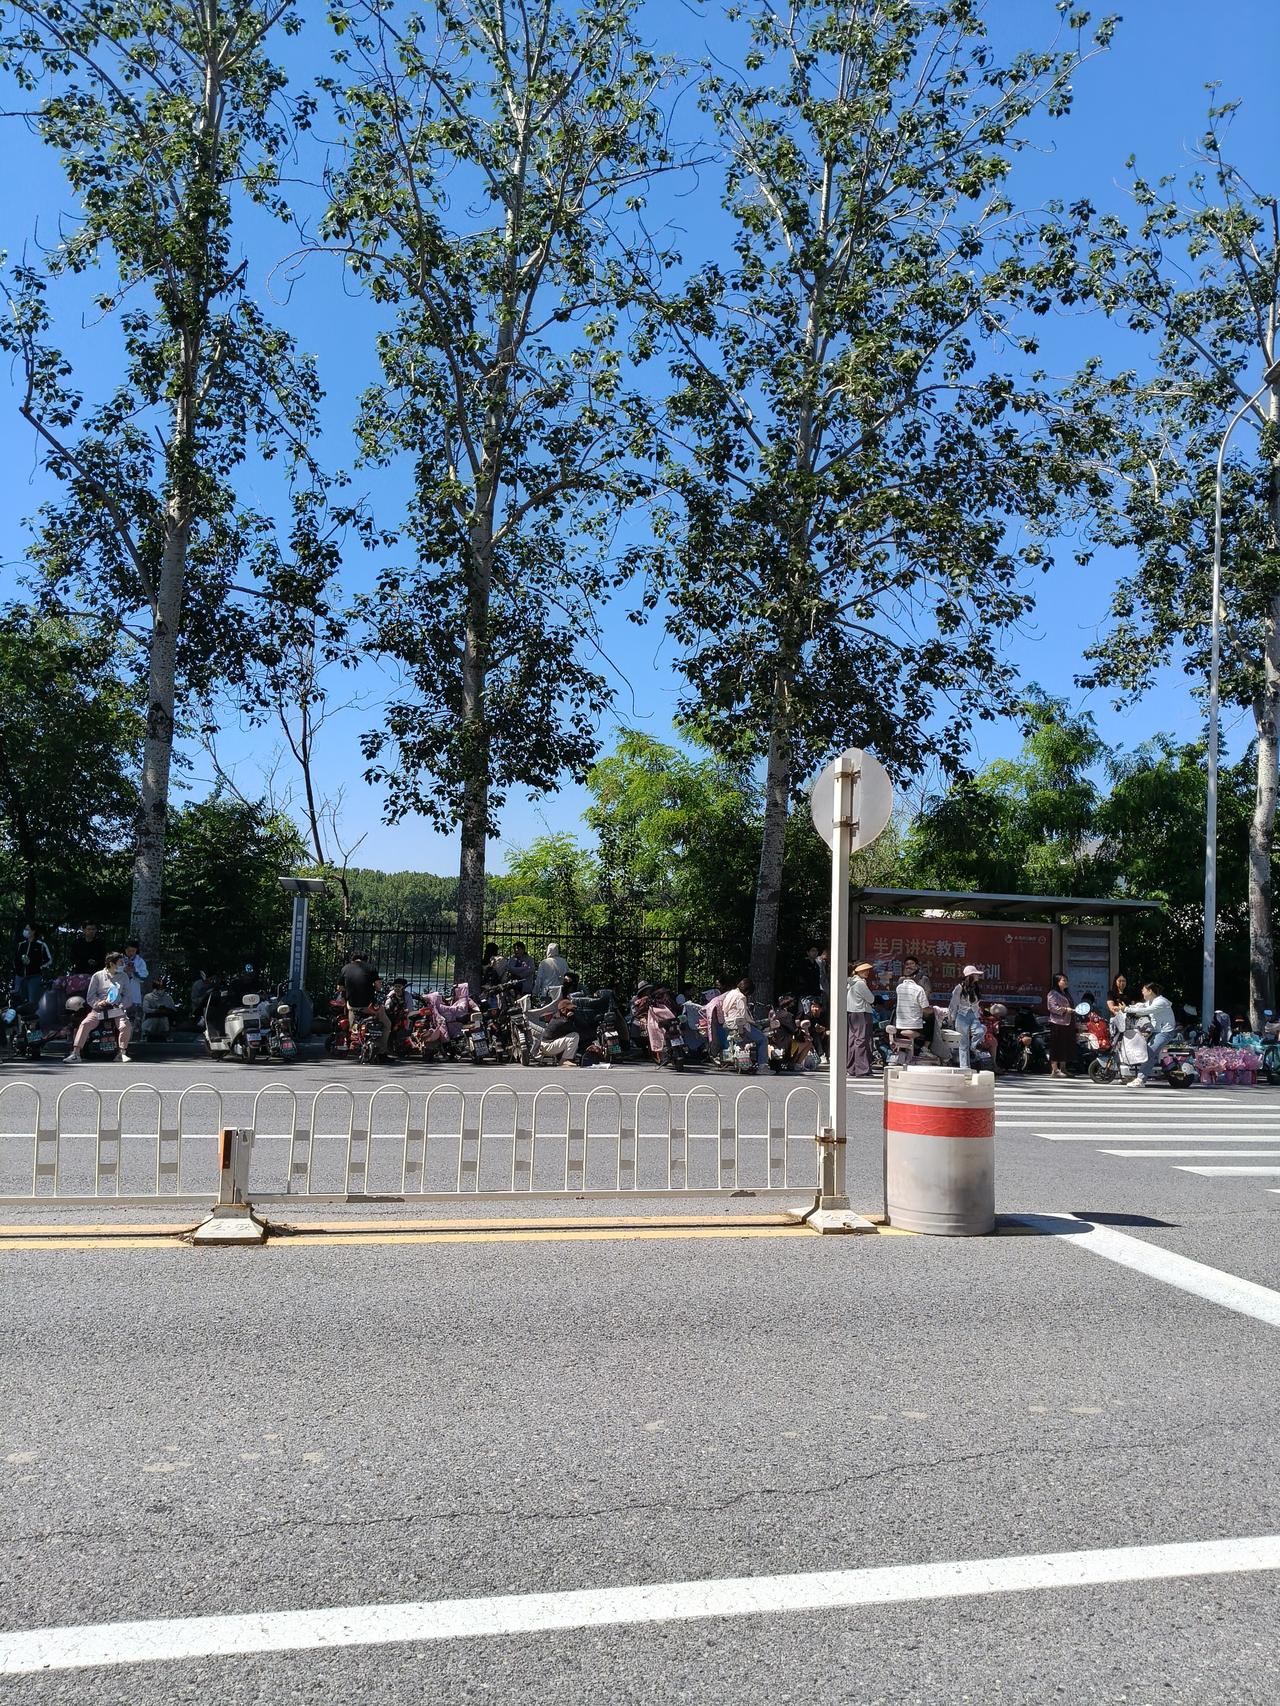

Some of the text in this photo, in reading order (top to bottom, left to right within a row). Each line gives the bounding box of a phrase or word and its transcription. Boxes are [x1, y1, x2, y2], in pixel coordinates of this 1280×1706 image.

[873, 937, 968, 958] 半月讲坛教育
